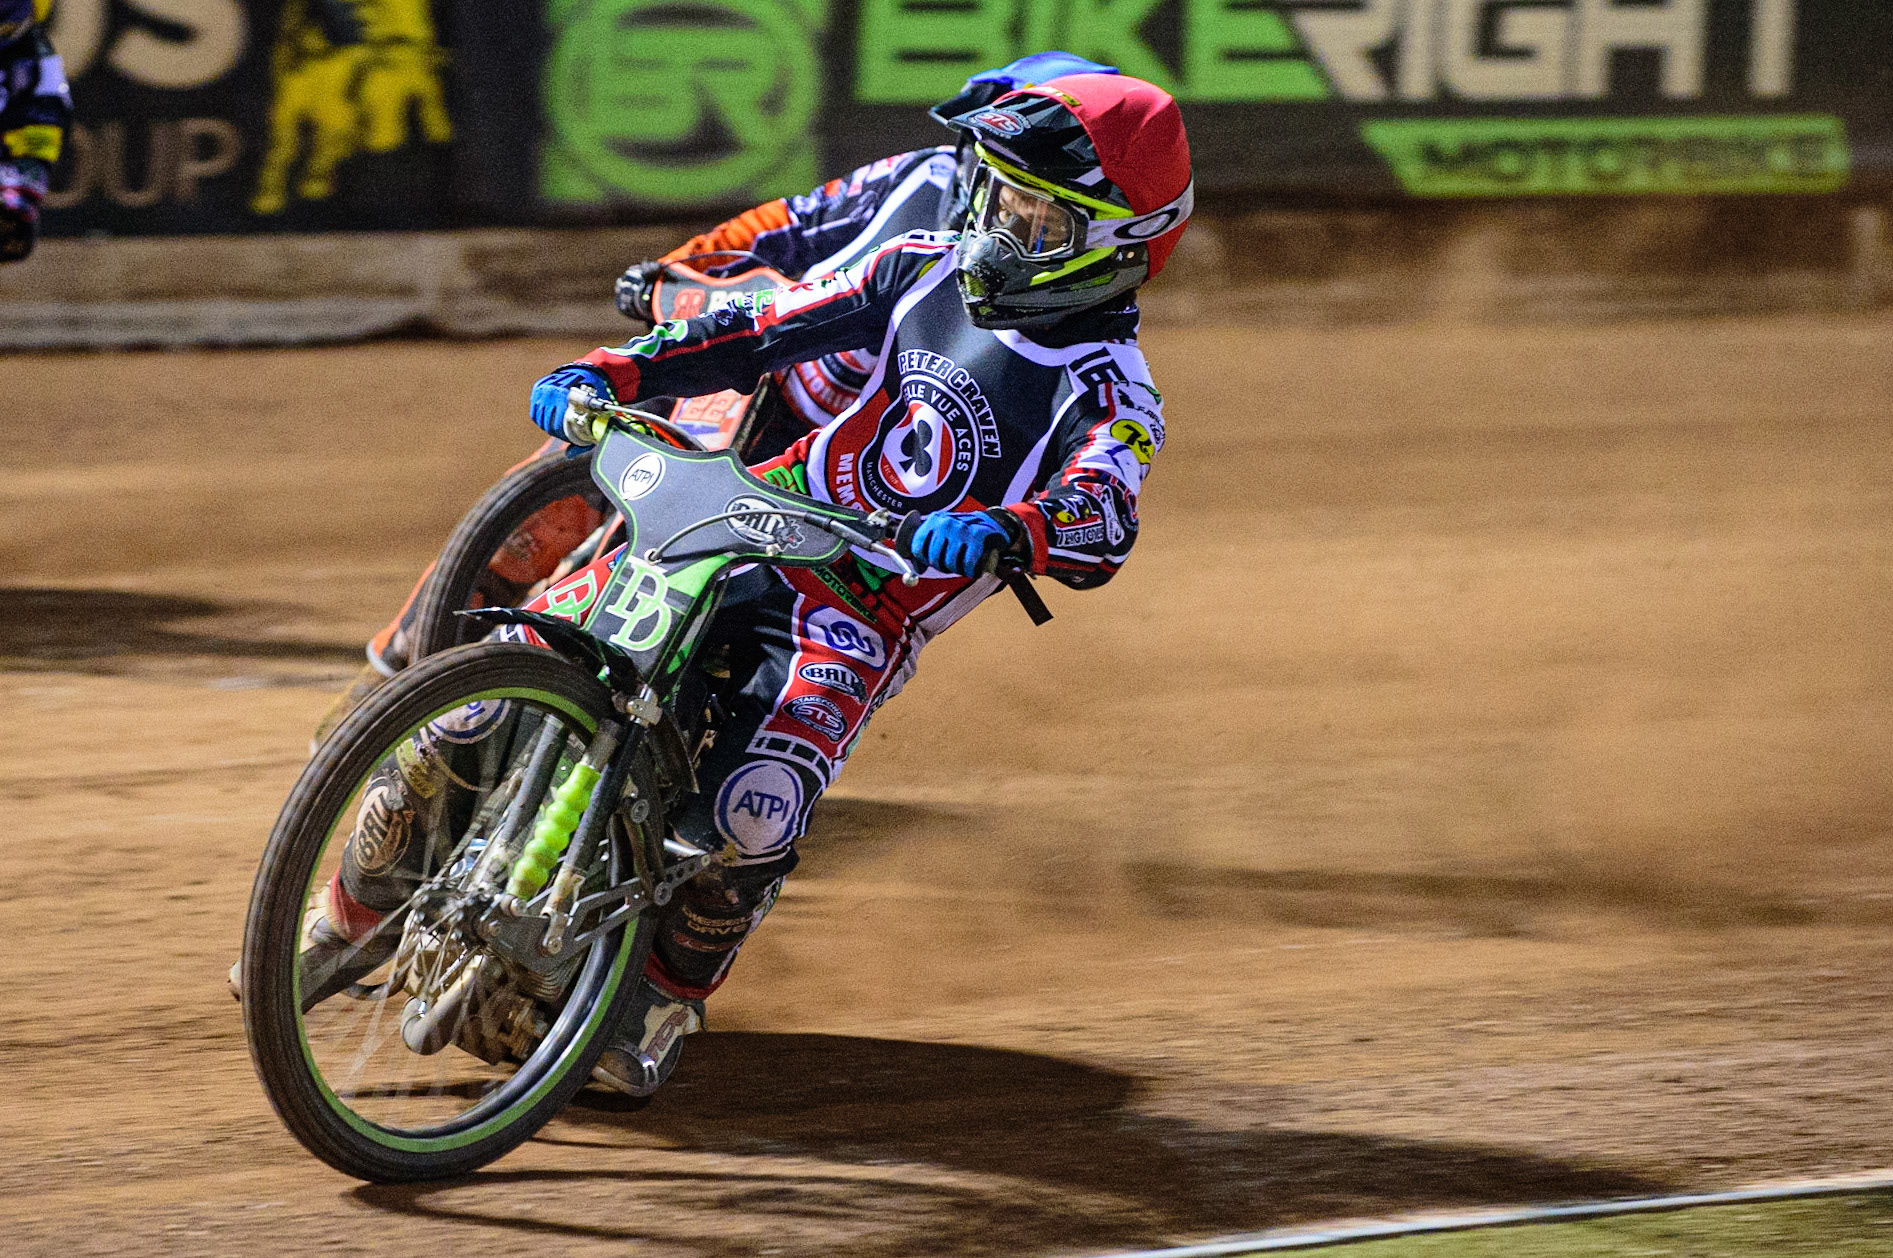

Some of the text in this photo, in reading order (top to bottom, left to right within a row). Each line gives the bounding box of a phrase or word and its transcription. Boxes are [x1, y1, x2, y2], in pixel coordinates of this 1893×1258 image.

[898, 349, 1001, 458] PETER CRAVEN
[903, 384, 972, 472] ELLE VUE ACES
[628, 468, 655, 485] ATPI
[865, 461, 903, 508] MANCHESTER
[798, 704, 841, 728] STS
[732, 788, 791, 823] ATPI
